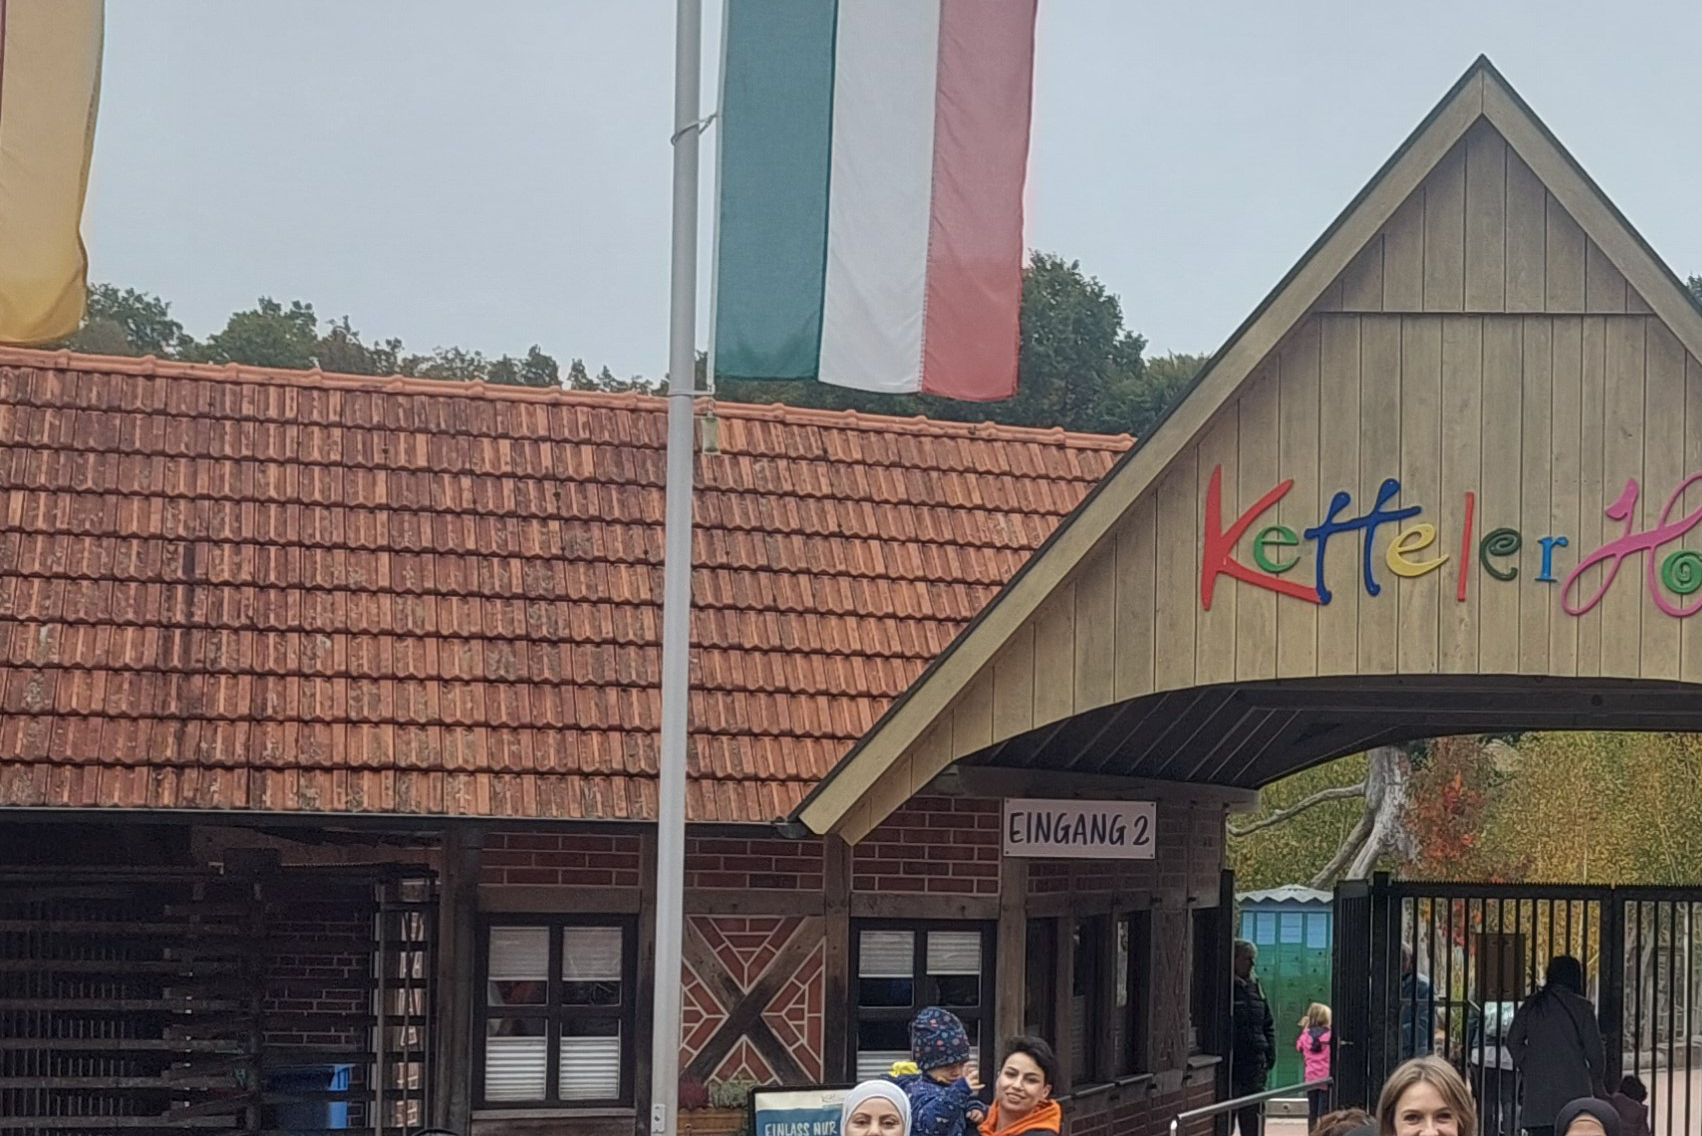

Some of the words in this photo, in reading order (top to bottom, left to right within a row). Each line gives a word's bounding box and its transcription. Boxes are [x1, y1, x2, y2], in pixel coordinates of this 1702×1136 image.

[1009, 811, 1127, 846] EINGANG
[1132, 815, 1150, 846] 2
[813, 1121, 838, 1136] NUR
